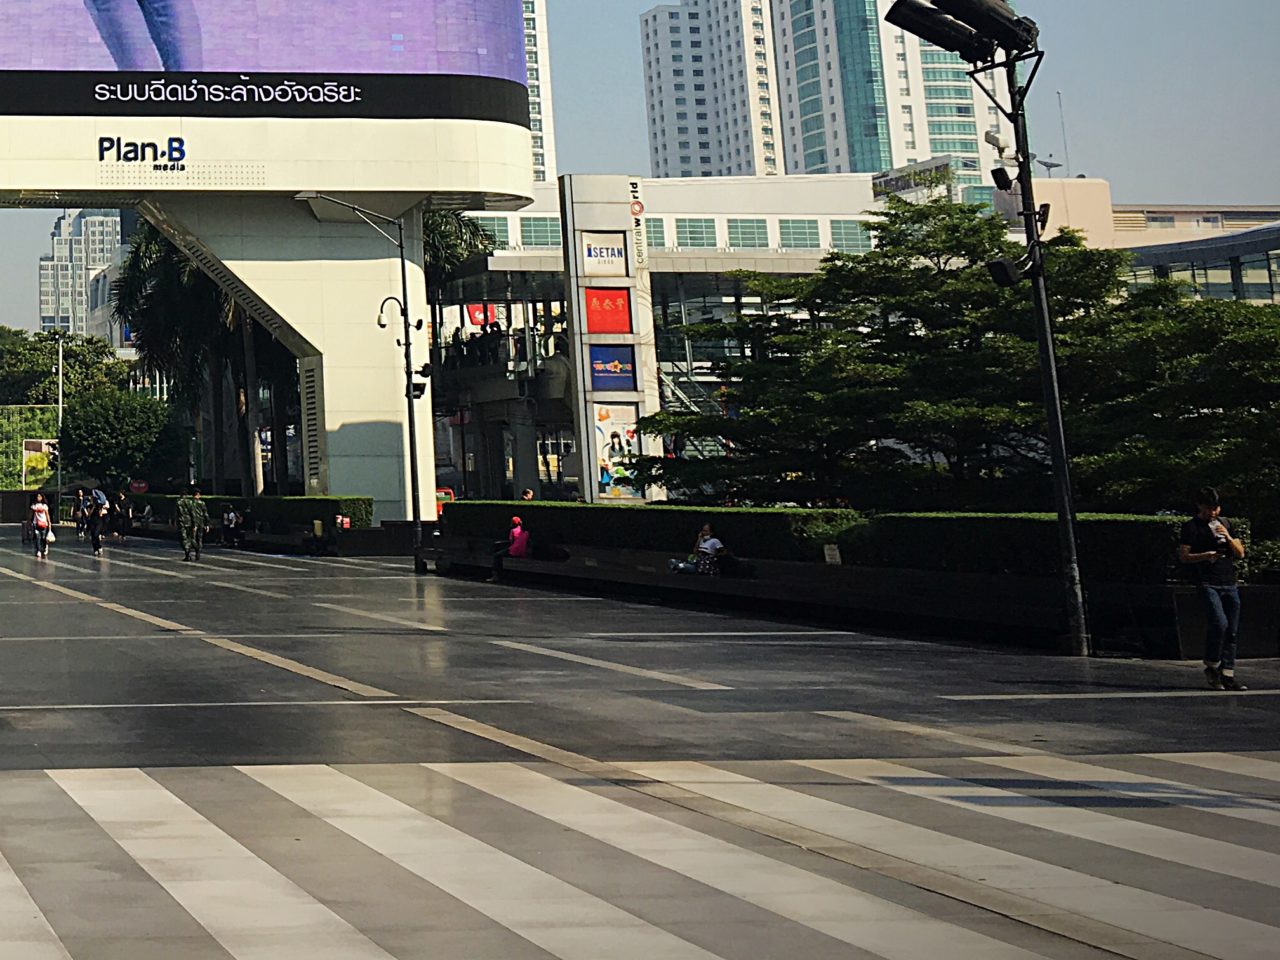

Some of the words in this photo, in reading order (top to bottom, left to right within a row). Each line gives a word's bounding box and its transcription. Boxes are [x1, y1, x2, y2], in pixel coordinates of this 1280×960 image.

[94, 75, 362, 103] ระบบฉีดชำระล้างอัจฉริยะ
[153, 162, 186, 172] media
[587, 243, 623, 258] ISETAN
